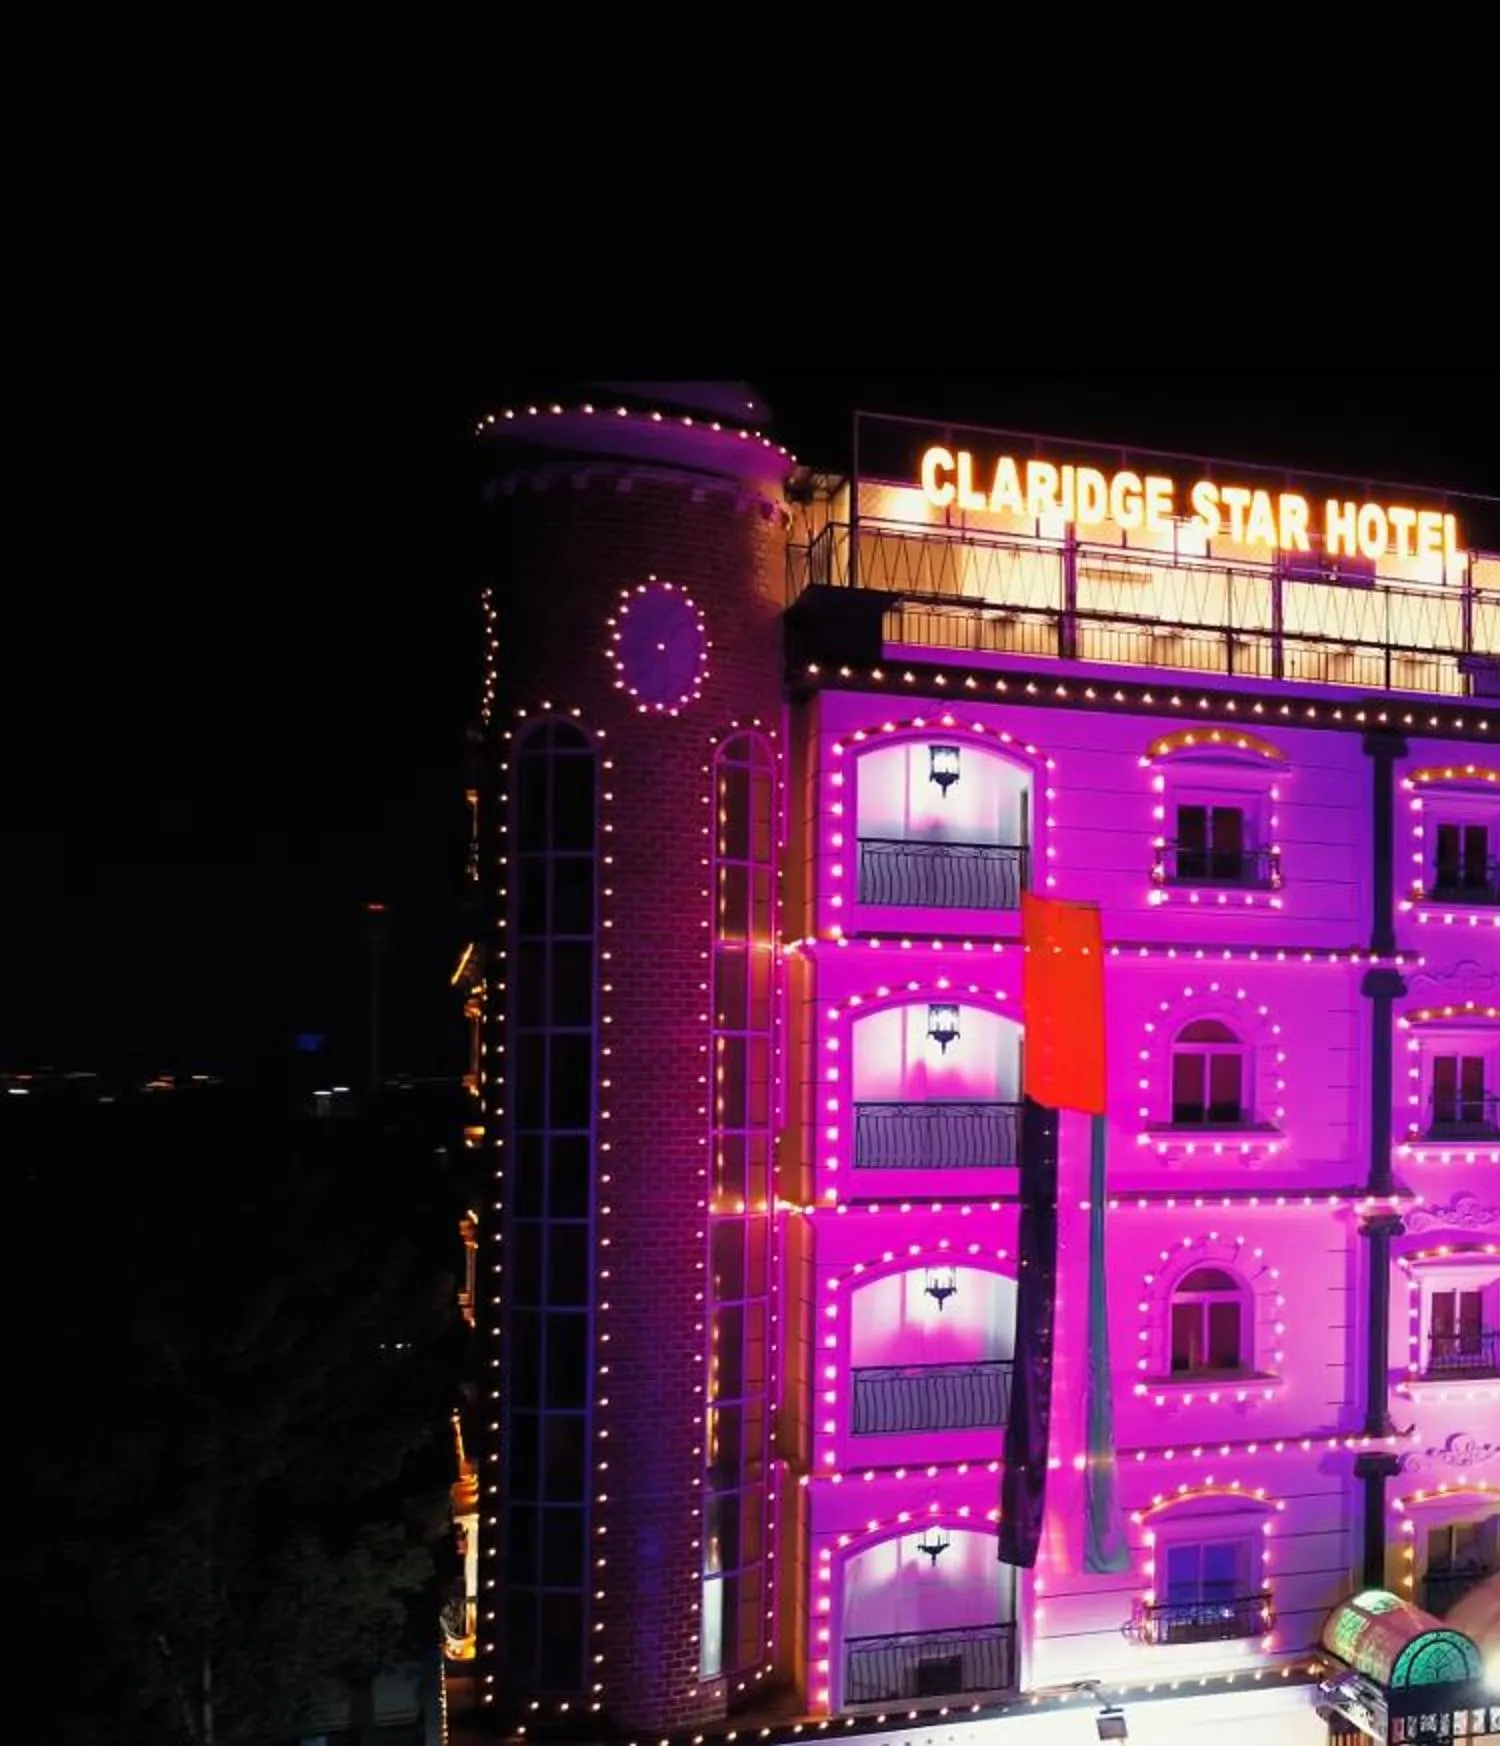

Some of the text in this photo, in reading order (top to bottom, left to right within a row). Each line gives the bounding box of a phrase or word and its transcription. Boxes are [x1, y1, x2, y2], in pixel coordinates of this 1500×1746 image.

[920, 446, 1467, 571] CLARIDGE STAR HOTEL
